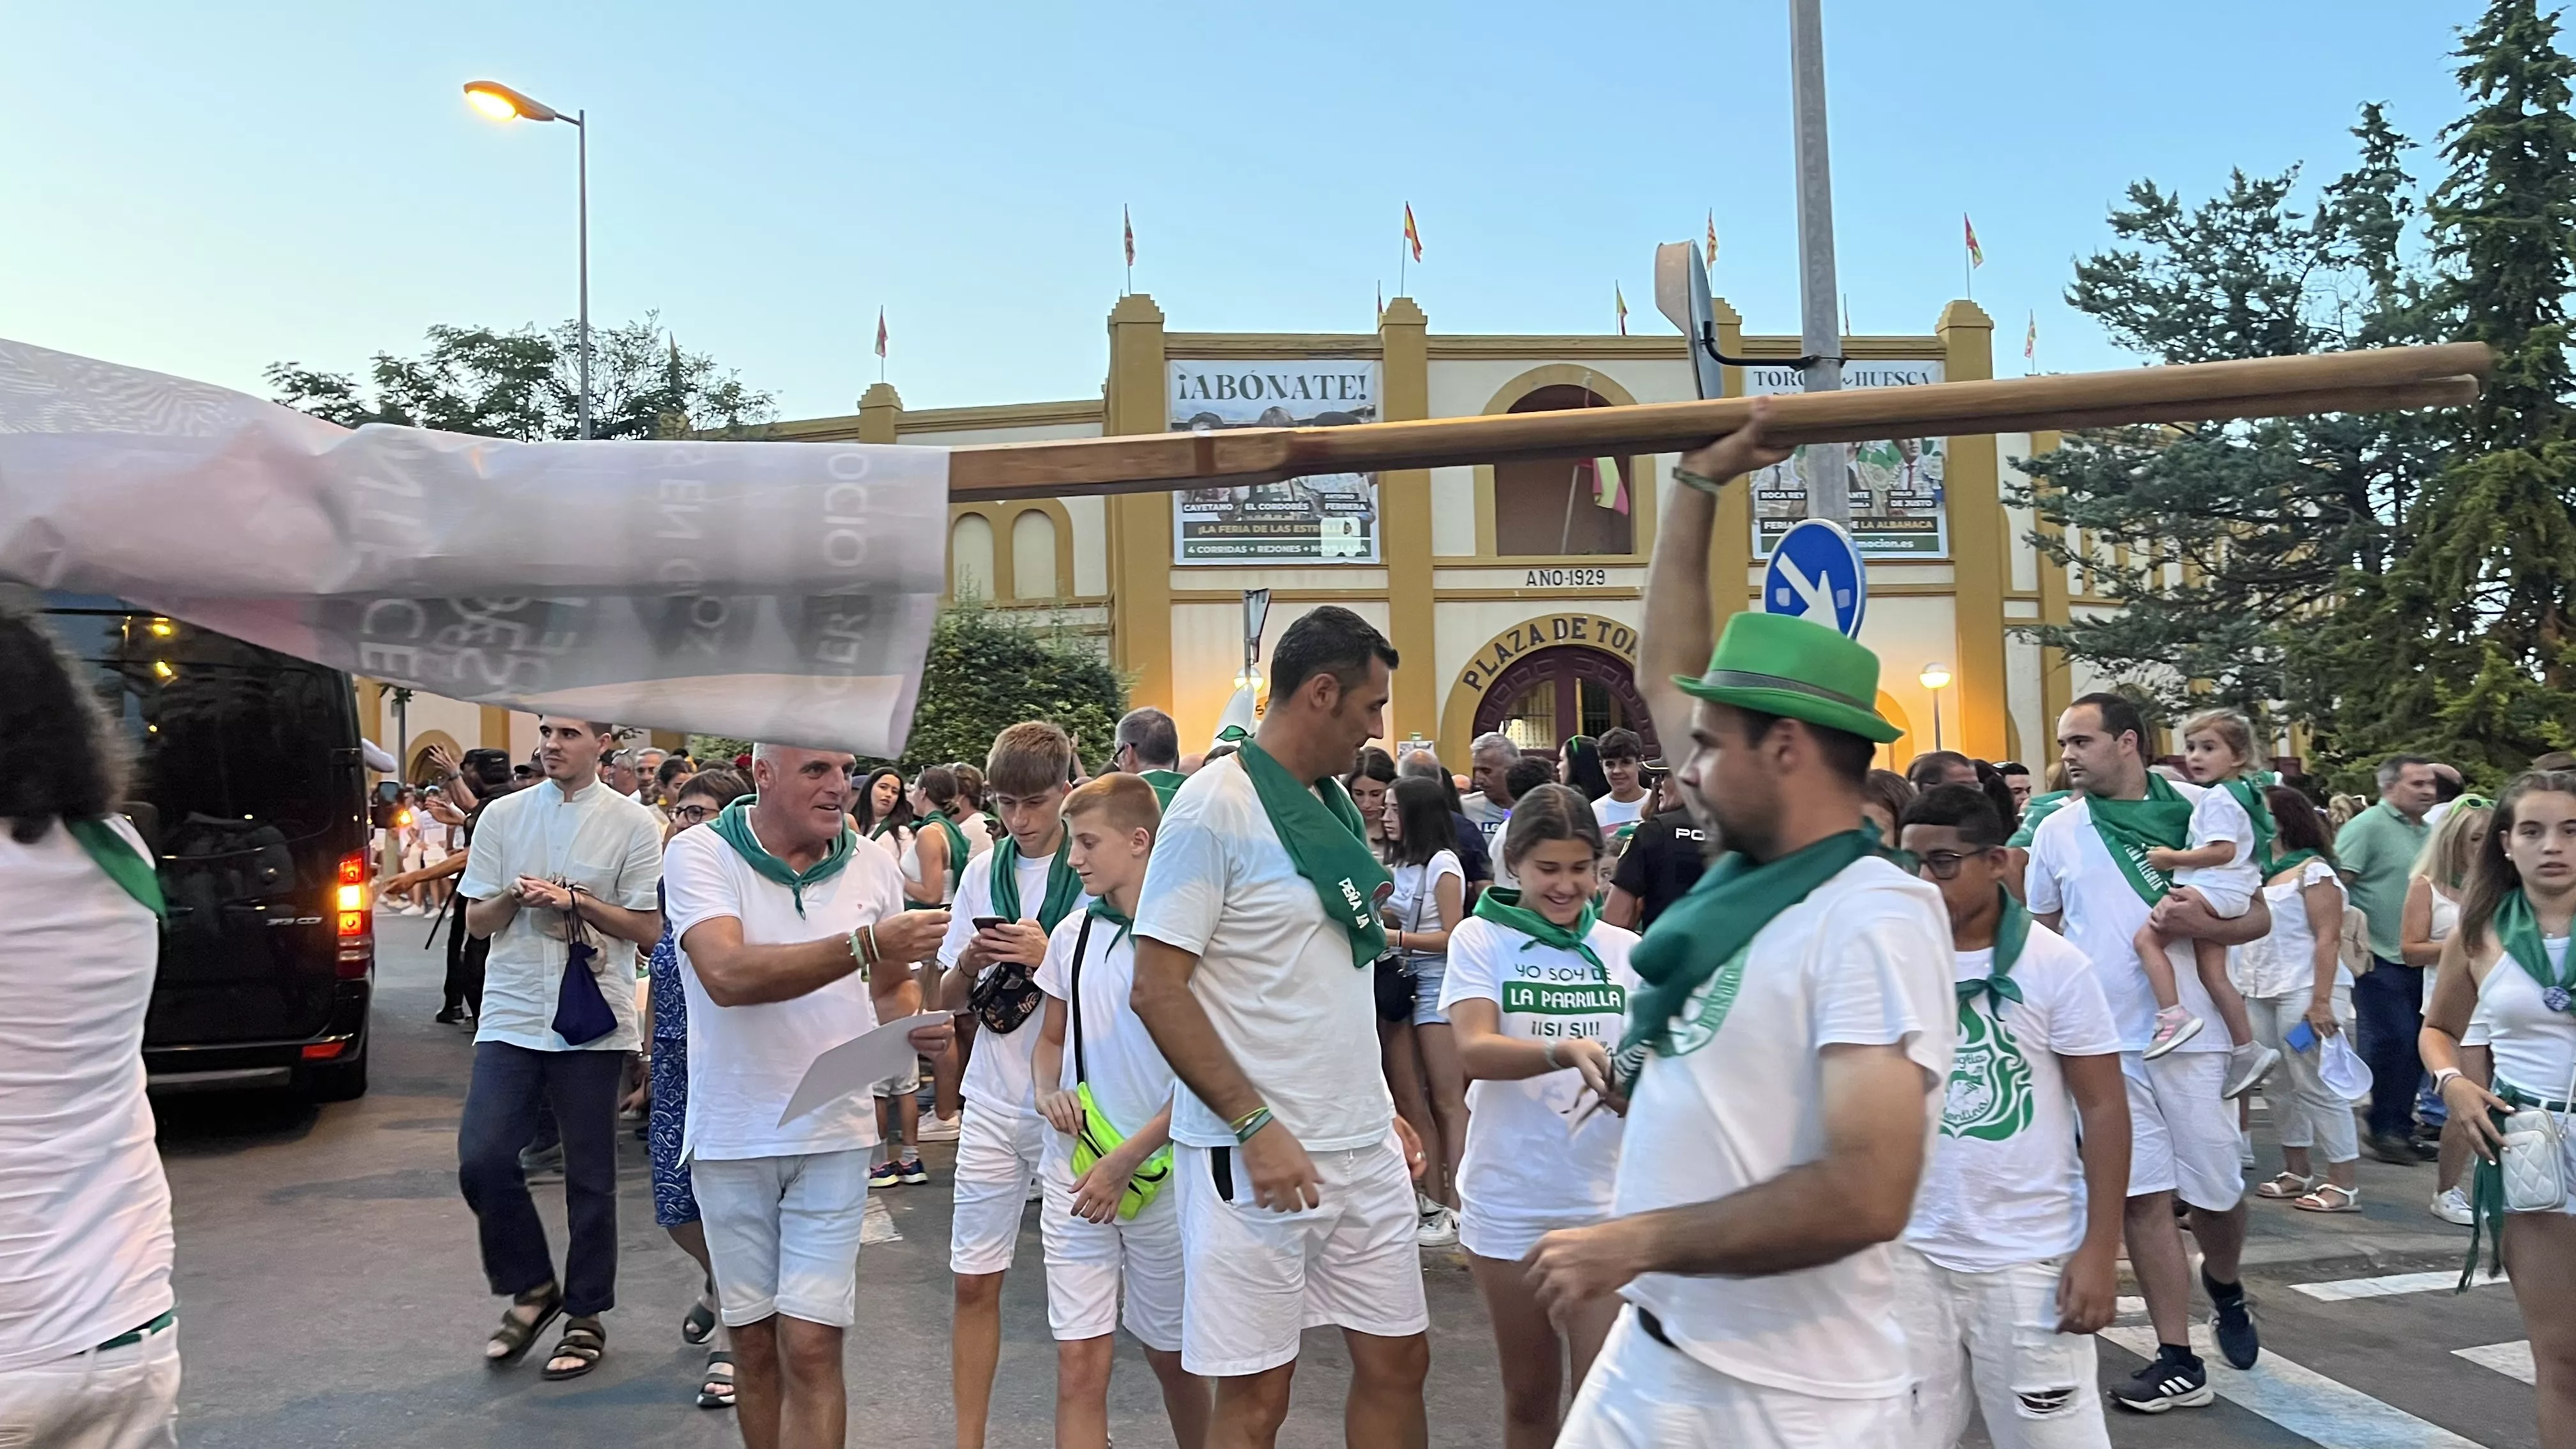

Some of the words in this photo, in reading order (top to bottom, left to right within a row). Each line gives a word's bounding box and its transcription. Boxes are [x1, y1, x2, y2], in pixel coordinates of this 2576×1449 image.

[1179, 370, 1367, 400] ¡ABÓNATE!
[1855, 371, 1929, 387] HUESCA
[1183, 503, 1234, 512] CAYETANO
[1218, 525, 1250, 533] FERIA
[1252, 525, 1268, 533] DE
[1270, 524, 1291, 533] LAS
[1860, 521, 1874, 529] LA
[1876, 521, 1934, 529] ALBAHACA
[1197, 546, 1247, 554] CORRIDAS
[1257, 545, 1302, 553] REJONES
[1462, 623, 1546, 693] PLAZA
[1552, 617, 1588, 640] DE
[1484, 823, 1500, 832] Le
[1338, 877, 1363, 912] PEÑA
[1355, 913, 1370, 929] LA
[1515, 963, 1542, 979] YO
[1549, 967, 1585, 981] SOY
[1510, 988, 1534, 1006] LA
[1540, 990, 1621, 1008] PARRILLA
